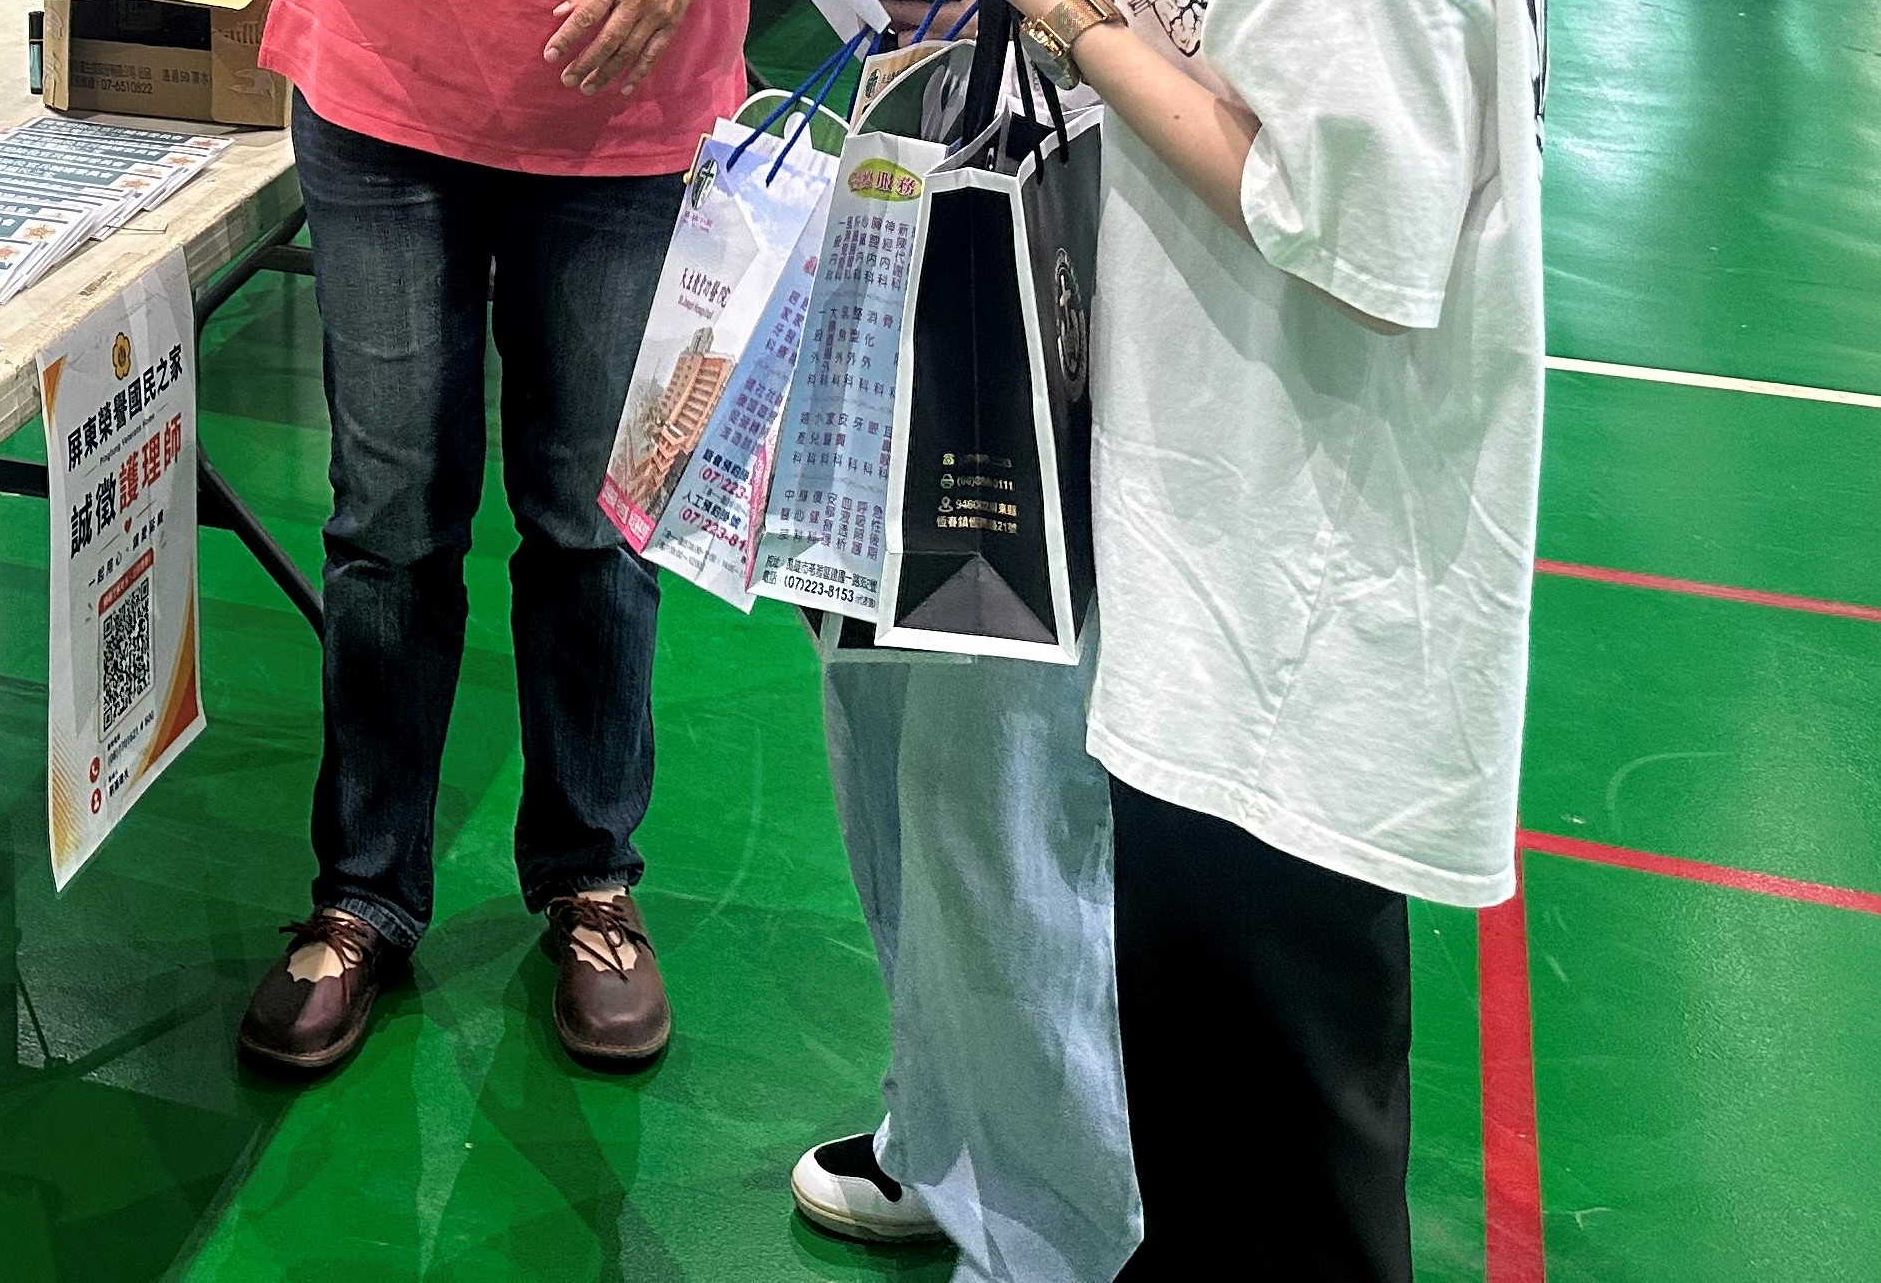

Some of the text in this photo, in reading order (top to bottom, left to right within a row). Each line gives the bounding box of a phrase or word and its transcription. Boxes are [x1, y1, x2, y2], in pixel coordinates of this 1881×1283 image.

[67, 343, 183, 473] 屏東榮譽國民之家
